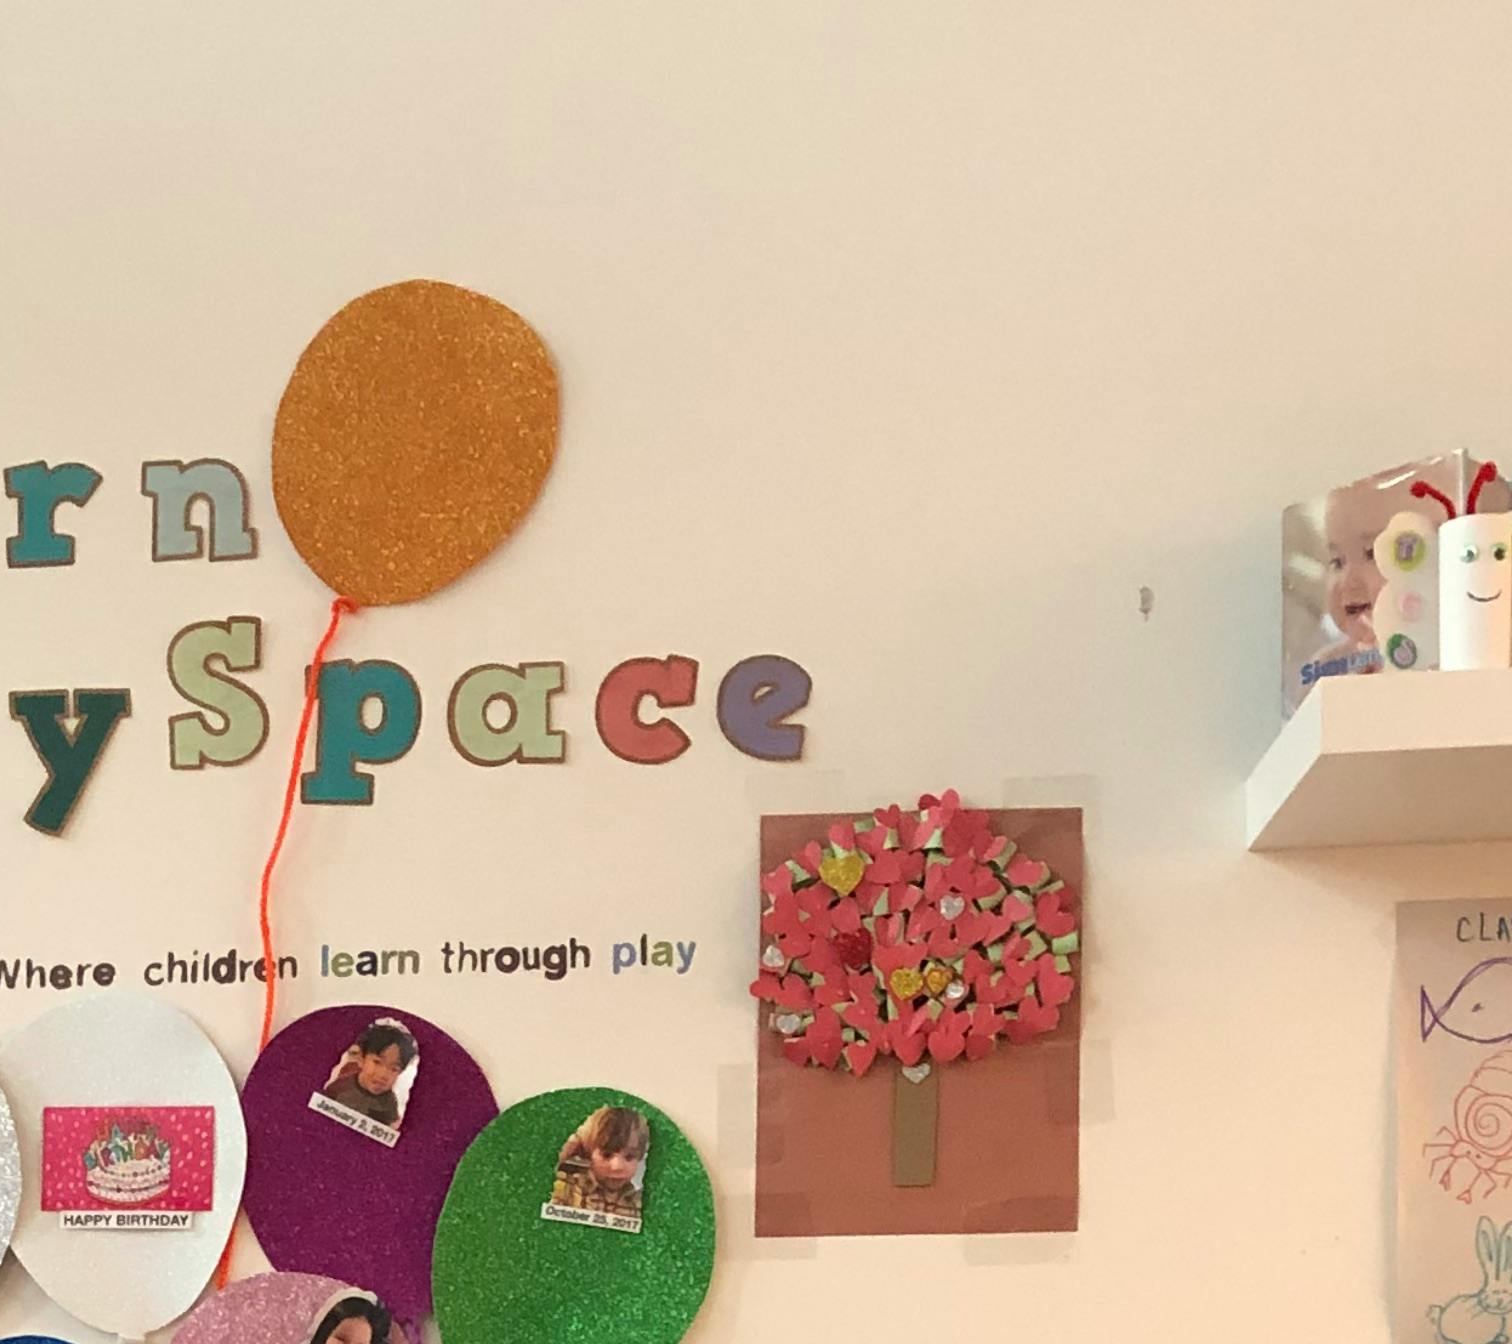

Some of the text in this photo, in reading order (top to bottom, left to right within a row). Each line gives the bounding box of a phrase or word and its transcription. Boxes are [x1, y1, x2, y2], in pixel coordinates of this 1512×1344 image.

[144, 943, 299, 988] children
[320, 941, 422, 978] learn
[441, 935, 592, 979] through
[612, 934, 698, 976] play
[315, 1098, 358, 1127] January
[370, 1122, 396, 1145] 2017
[63, 1214, 190, 1227] HAPPY BIRTHDAY
[612, 1217, 639, 1230] 2017
